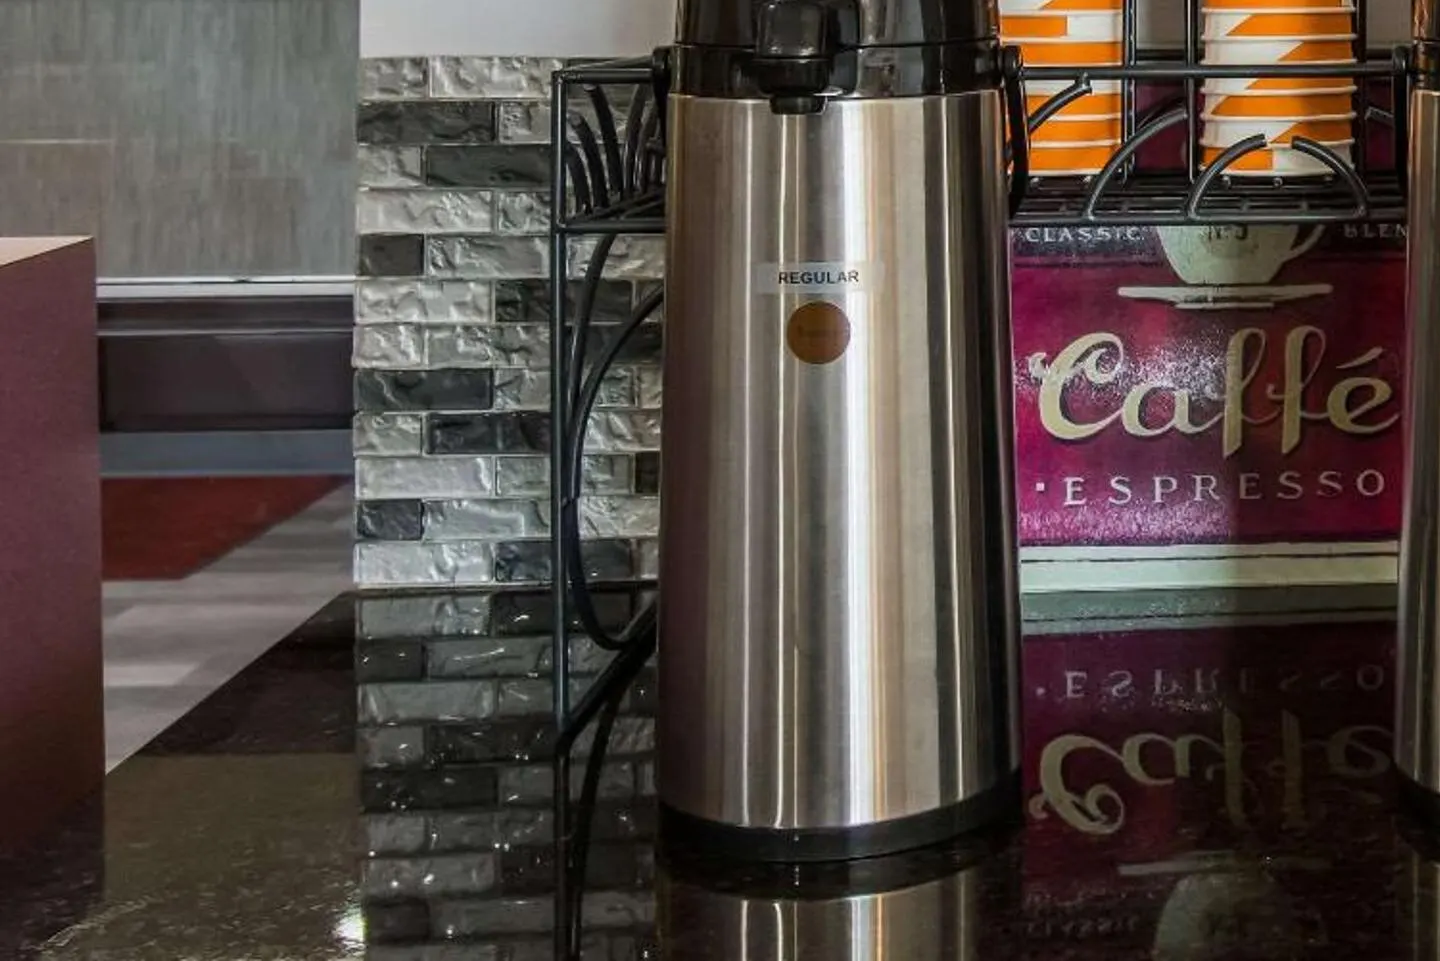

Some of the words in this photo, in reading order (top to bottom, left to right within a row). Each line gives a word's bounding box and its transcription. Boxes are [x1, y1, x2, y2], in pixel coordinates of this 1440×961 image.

[1025, 226, 1141, 242] CLASSIC
[778, 270, 859, 284] REGULAR
[1028, 325, 1400, 459] Caffé
[1063, 469, 1386, 506] ESPRESSO
